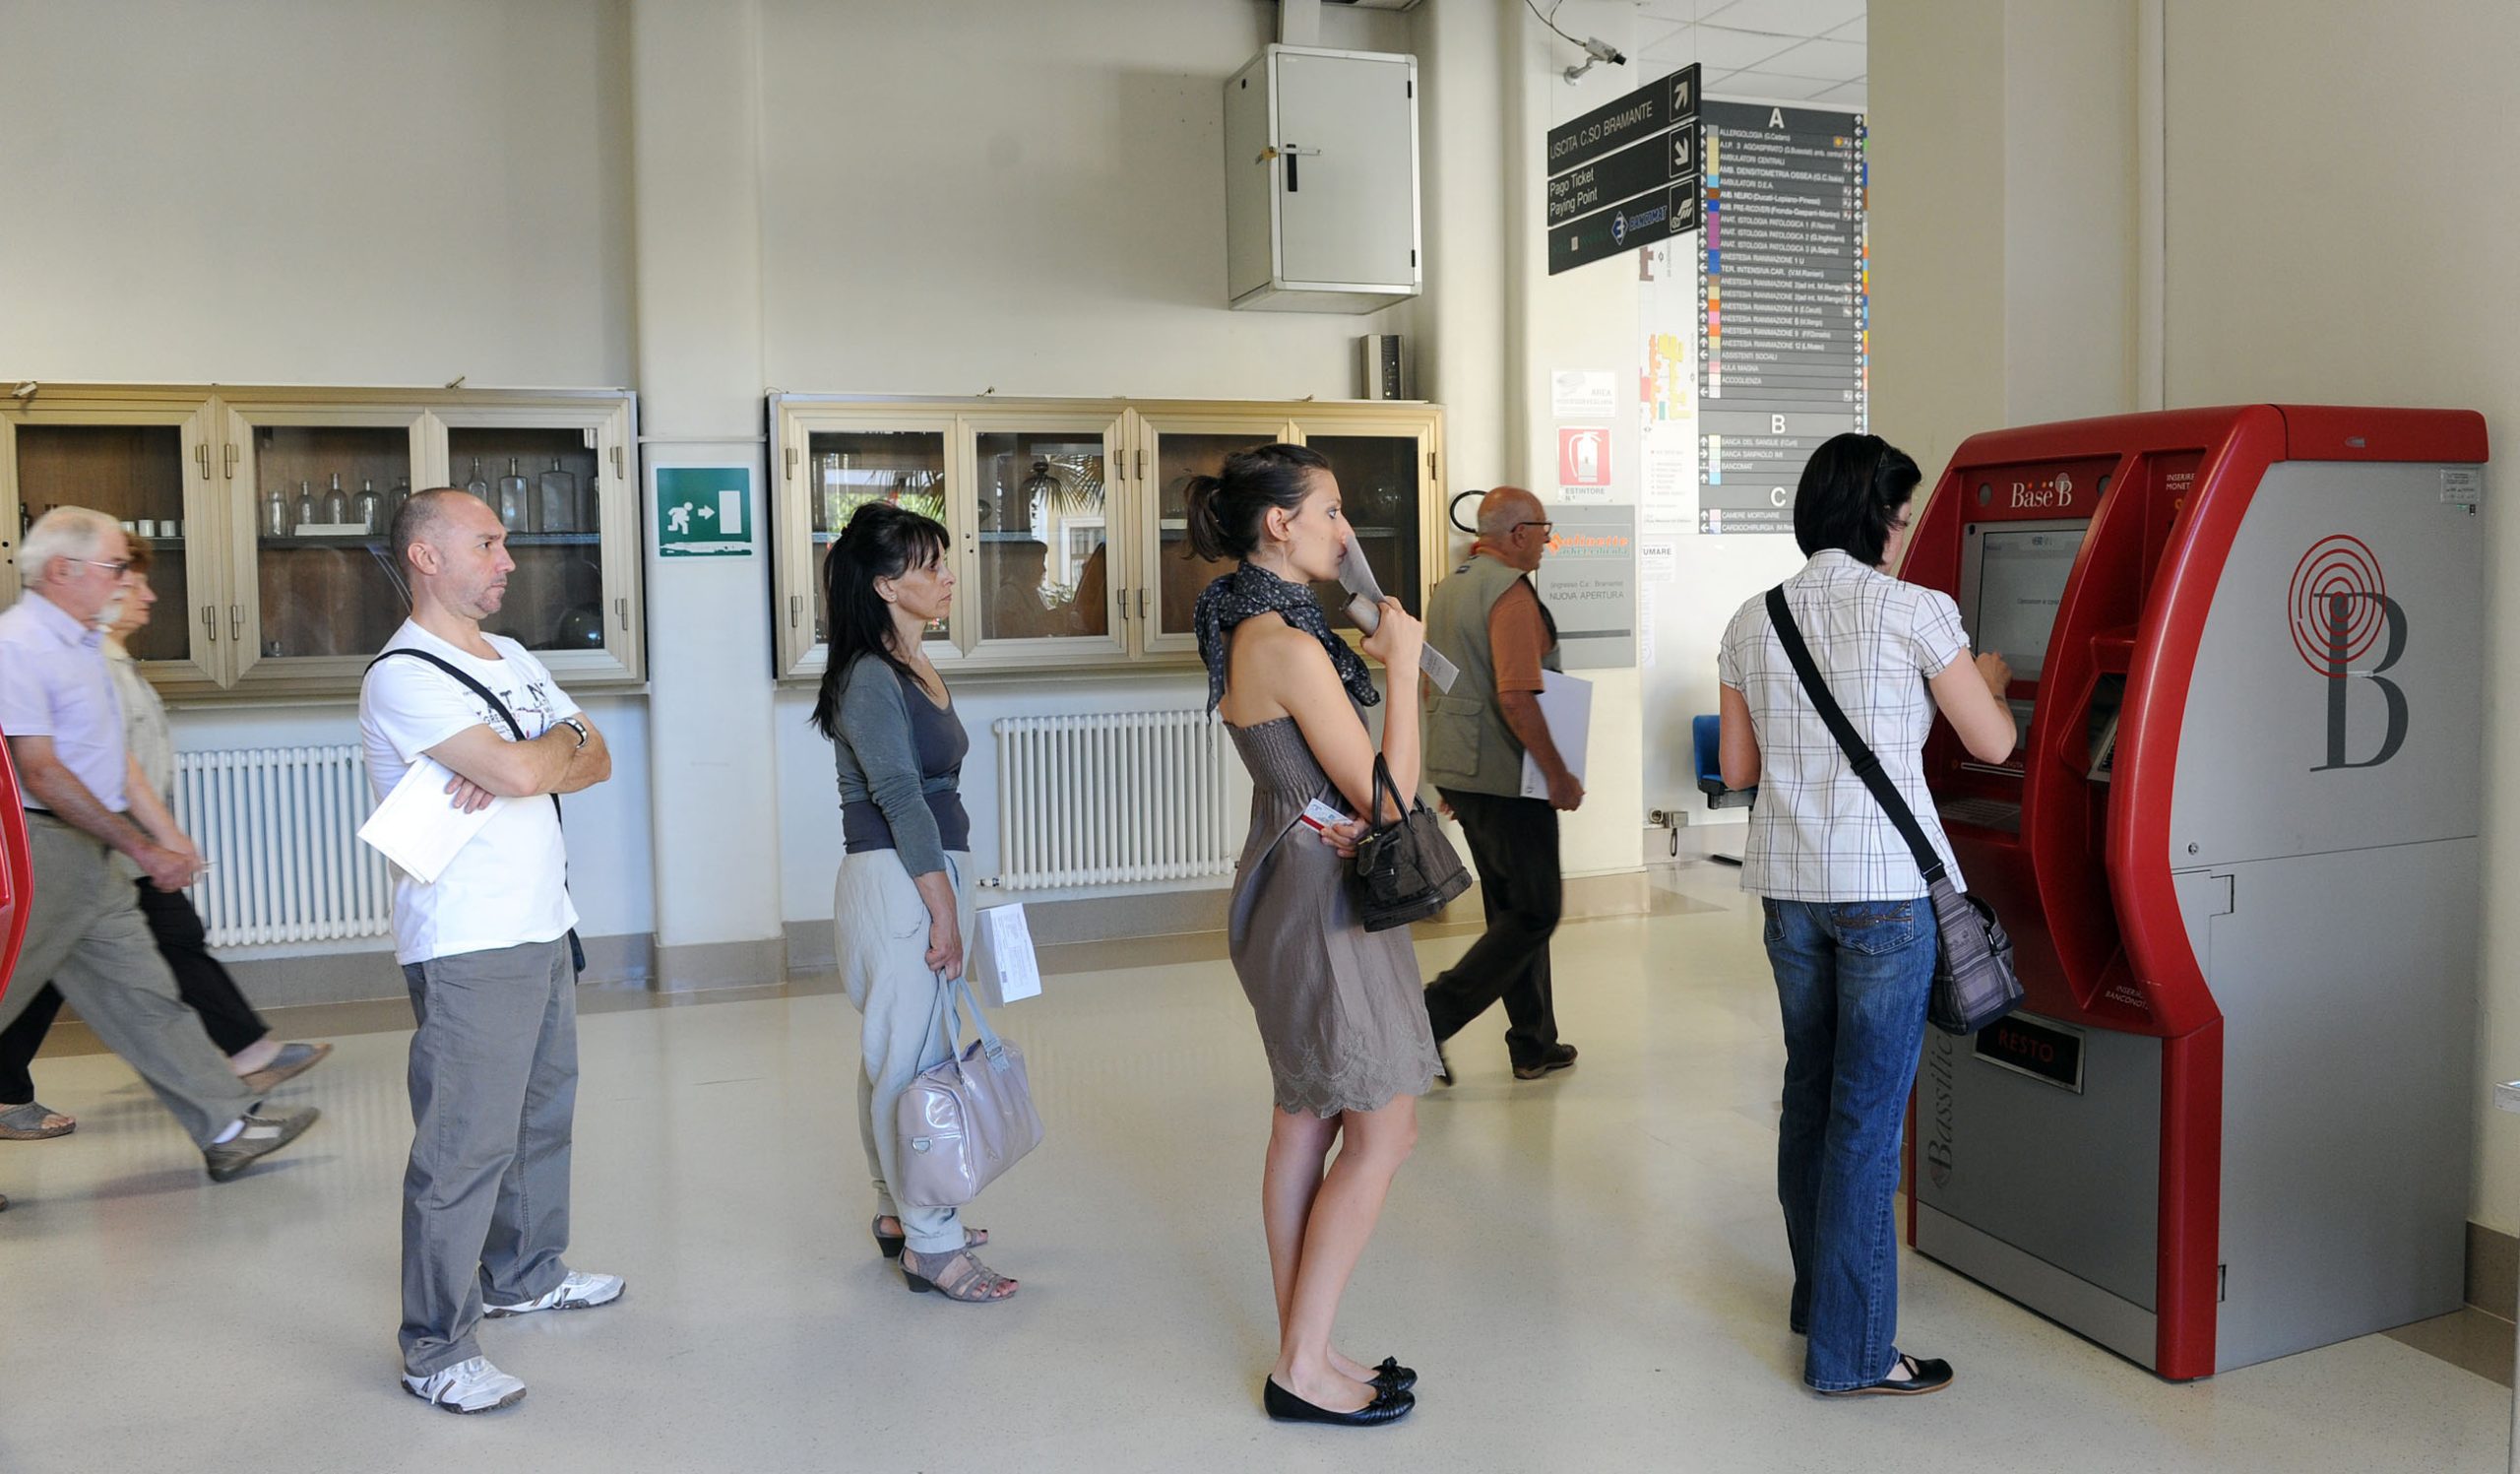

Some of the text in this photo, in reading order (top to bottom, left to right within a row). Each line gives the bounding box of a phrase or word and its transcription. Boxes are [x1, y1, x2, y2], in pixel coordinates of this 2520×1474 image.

[1580, 125, 1602, 147] C.SO
[1604, 100, 1654, 137] BRAMANTE
[1768, 107, 1785, 129] A
[1757, 157, 1786, 165] CENTRALI
[1549, 168, 1595, 199] Pago Ticket
[1736, 167, 1790, 178] DENSITOMETRIA
[1791, 171, 1813, 180] OSSEA
[1549, 188, 1599, 217] Paying Point
[1771, 414, 1787, 434] B
[1770, 486, 1787, 507] C
[2010, 480, 2073, 508] Base B
[2166, 481, 2190, 490] MONET
[1549, 591, 1625, 601] NUOVA APERTURA
[2309, 591, 2409, 774] B
[2105, 991, 2150, 1010] BANCONOT
[1998, 1027, 2054, 1063] RESTO
[1928, 1033, 1954, 1171] Bassilic
